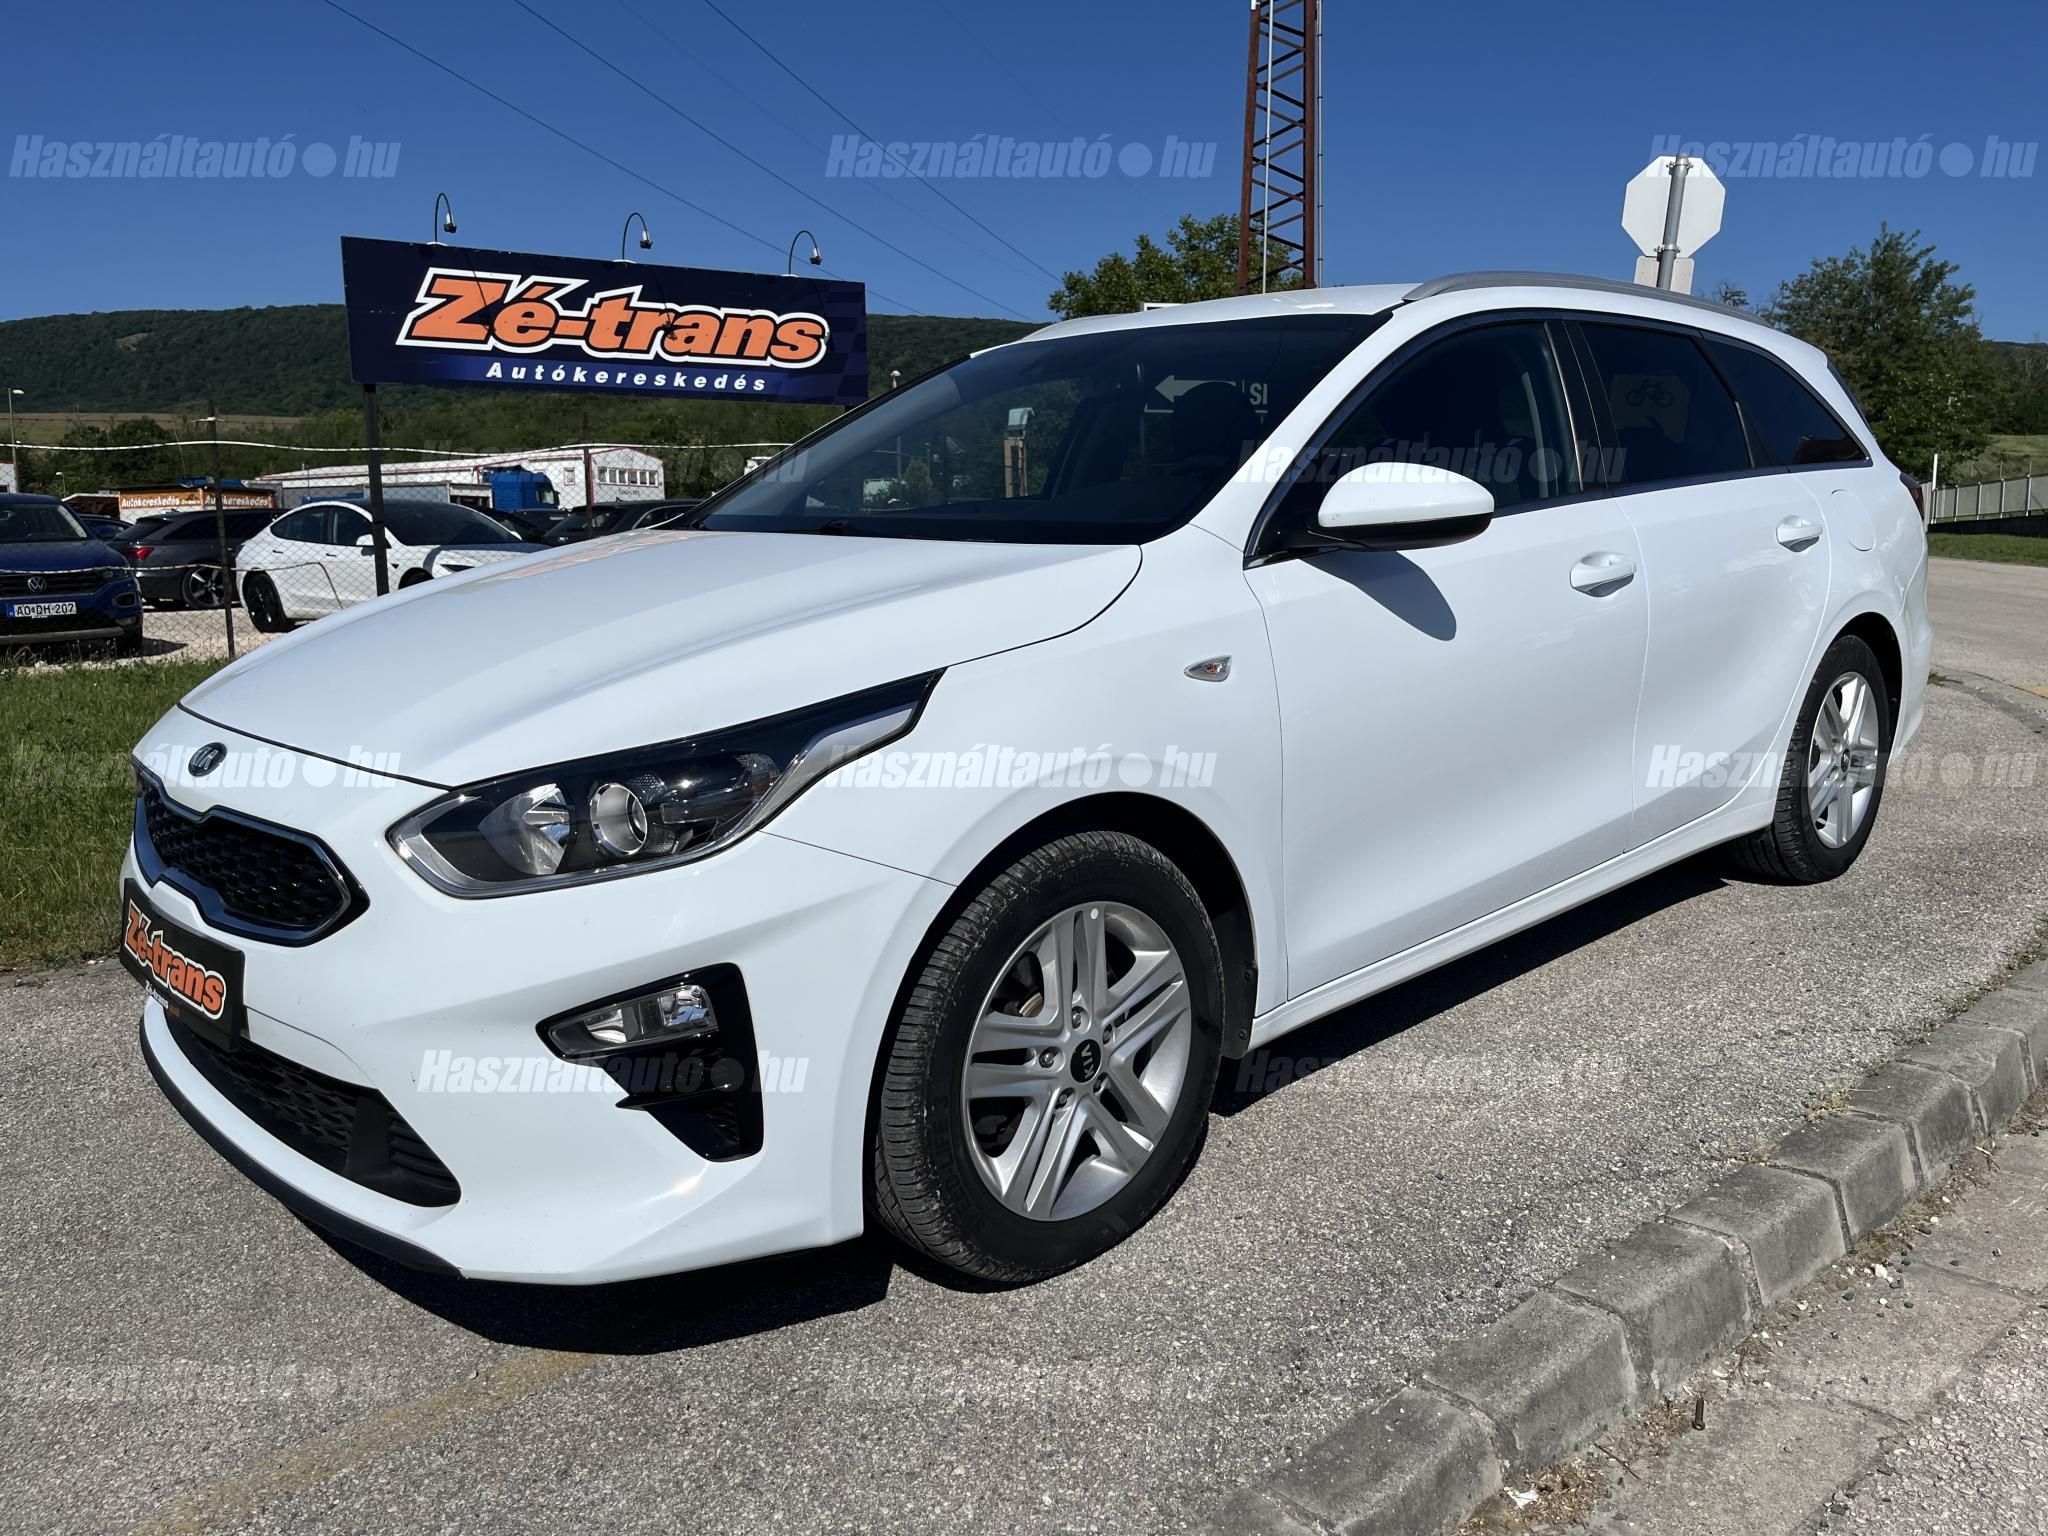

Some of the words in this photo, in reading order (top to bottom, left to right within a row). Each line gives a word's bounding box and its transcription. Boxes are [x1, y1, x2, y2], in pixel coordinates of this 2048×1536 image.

[397, 267, 830, 368] Zé-trans
[486, 361, 767, 391] Autókereskedés
[125, 899, 227, 1020] Zé-trans
[1081, 1043, 1095, 1080] KIA
